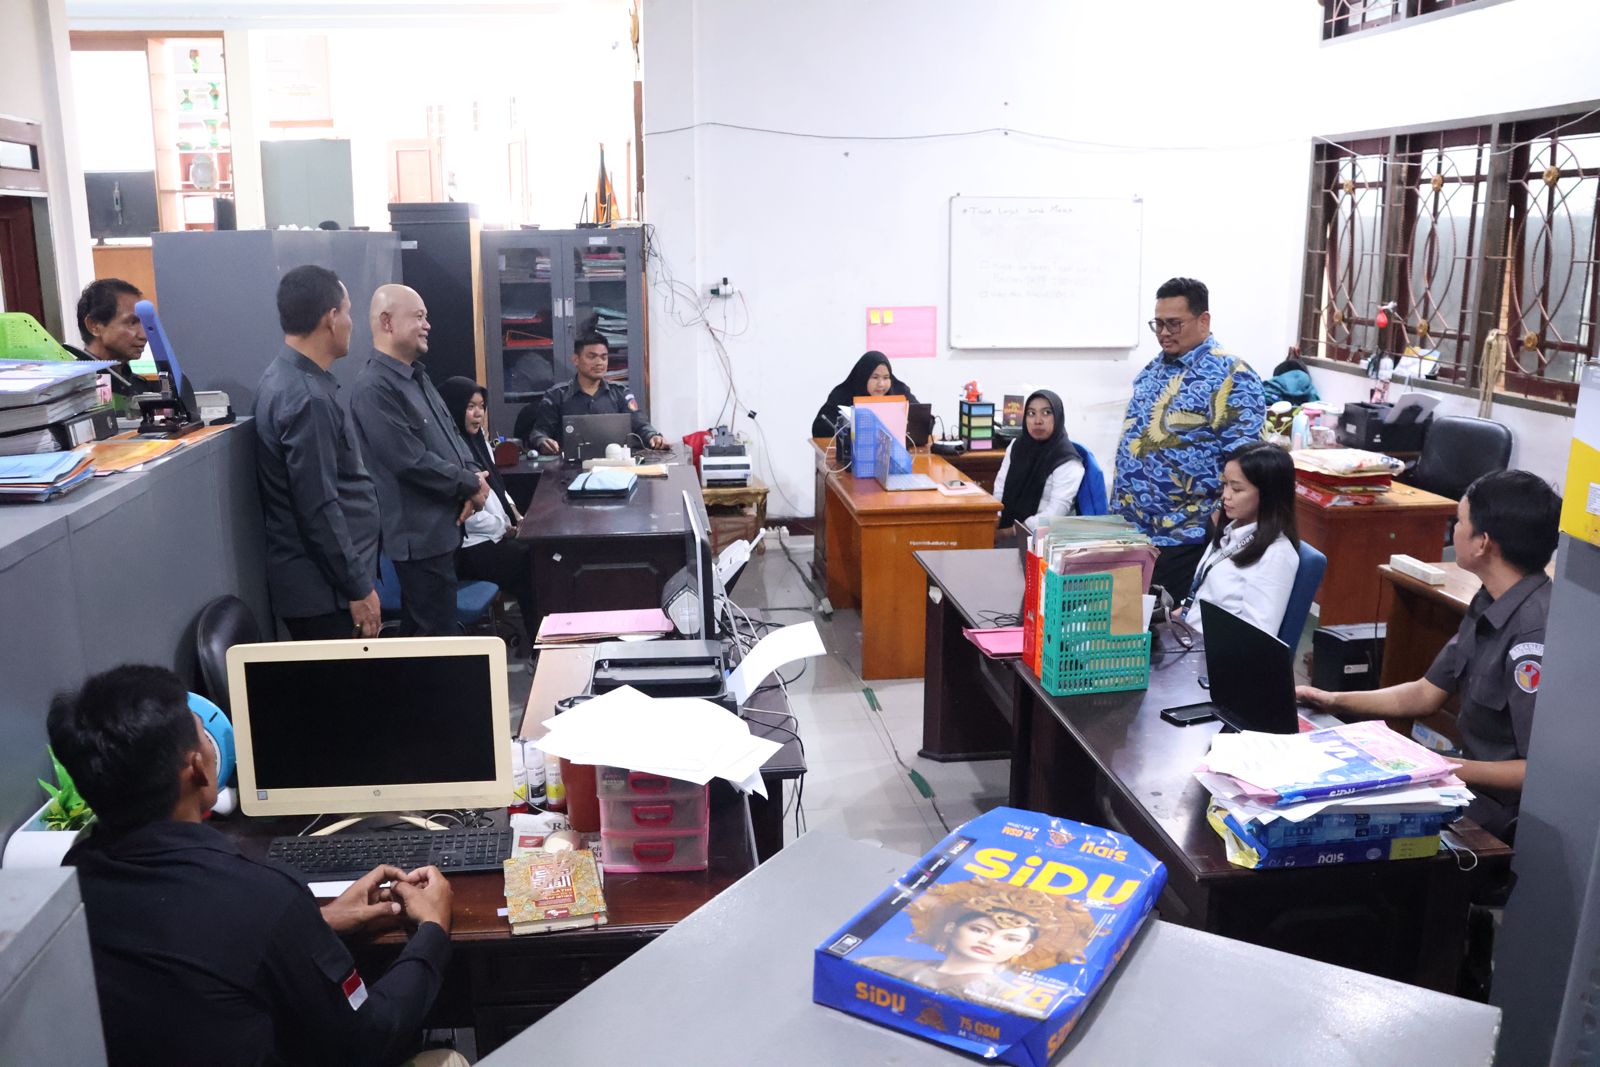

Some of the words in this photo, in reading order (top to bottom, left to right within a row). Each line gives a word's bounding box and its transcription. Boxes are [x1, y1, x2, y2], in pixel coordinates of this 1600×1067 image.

[552, 822, 576, 832] RA
[1079, 841, 1129, 862] SiDU
[1317, 852, 1344, 864] SiDU
[964, 848, 1141, 905] SiDU
[855, 981, 906, 1013] SiDU
